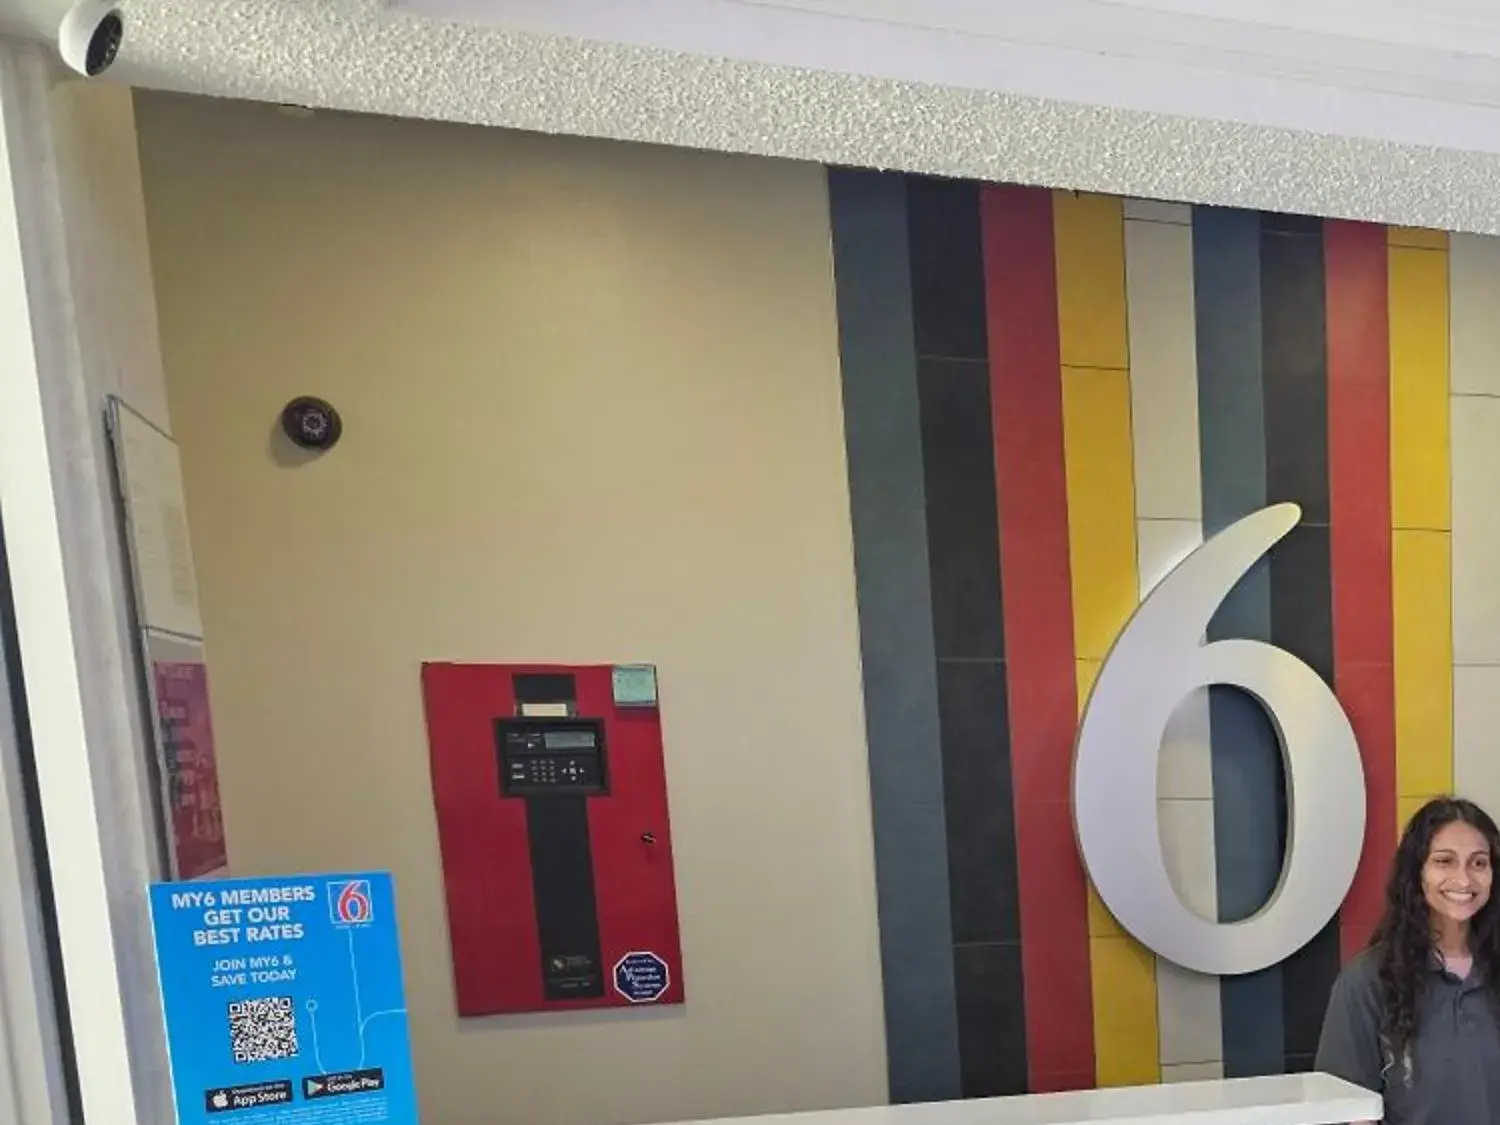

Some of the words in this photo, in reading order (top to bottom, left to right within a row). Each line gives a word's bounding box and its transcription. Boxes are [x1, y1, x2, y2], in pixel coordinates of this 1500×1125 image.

[1074, 502, 1366, 975] 6
[171, 891, 215, 909] MY6
[220, 885, 316, 905] MEMBERS
[337, 880, 369, 922] 6
[204, 908, 242, 926] GET
[247, 905, 290, 923] OUR
[193, 927, 241, 946] BEST
[246, 923, 304, 942] RATES
[211, 959, 247, 972] JOIN
[249, 955, 279, 969] MY6
[211, 973, 247, 988] SAVE
[250, 968, 297, 983] TODAY
[361, 1077, 380, 1088] Play
[233, 1095, 257, 1107] App
[257, 1091, 287, 1103] Store
